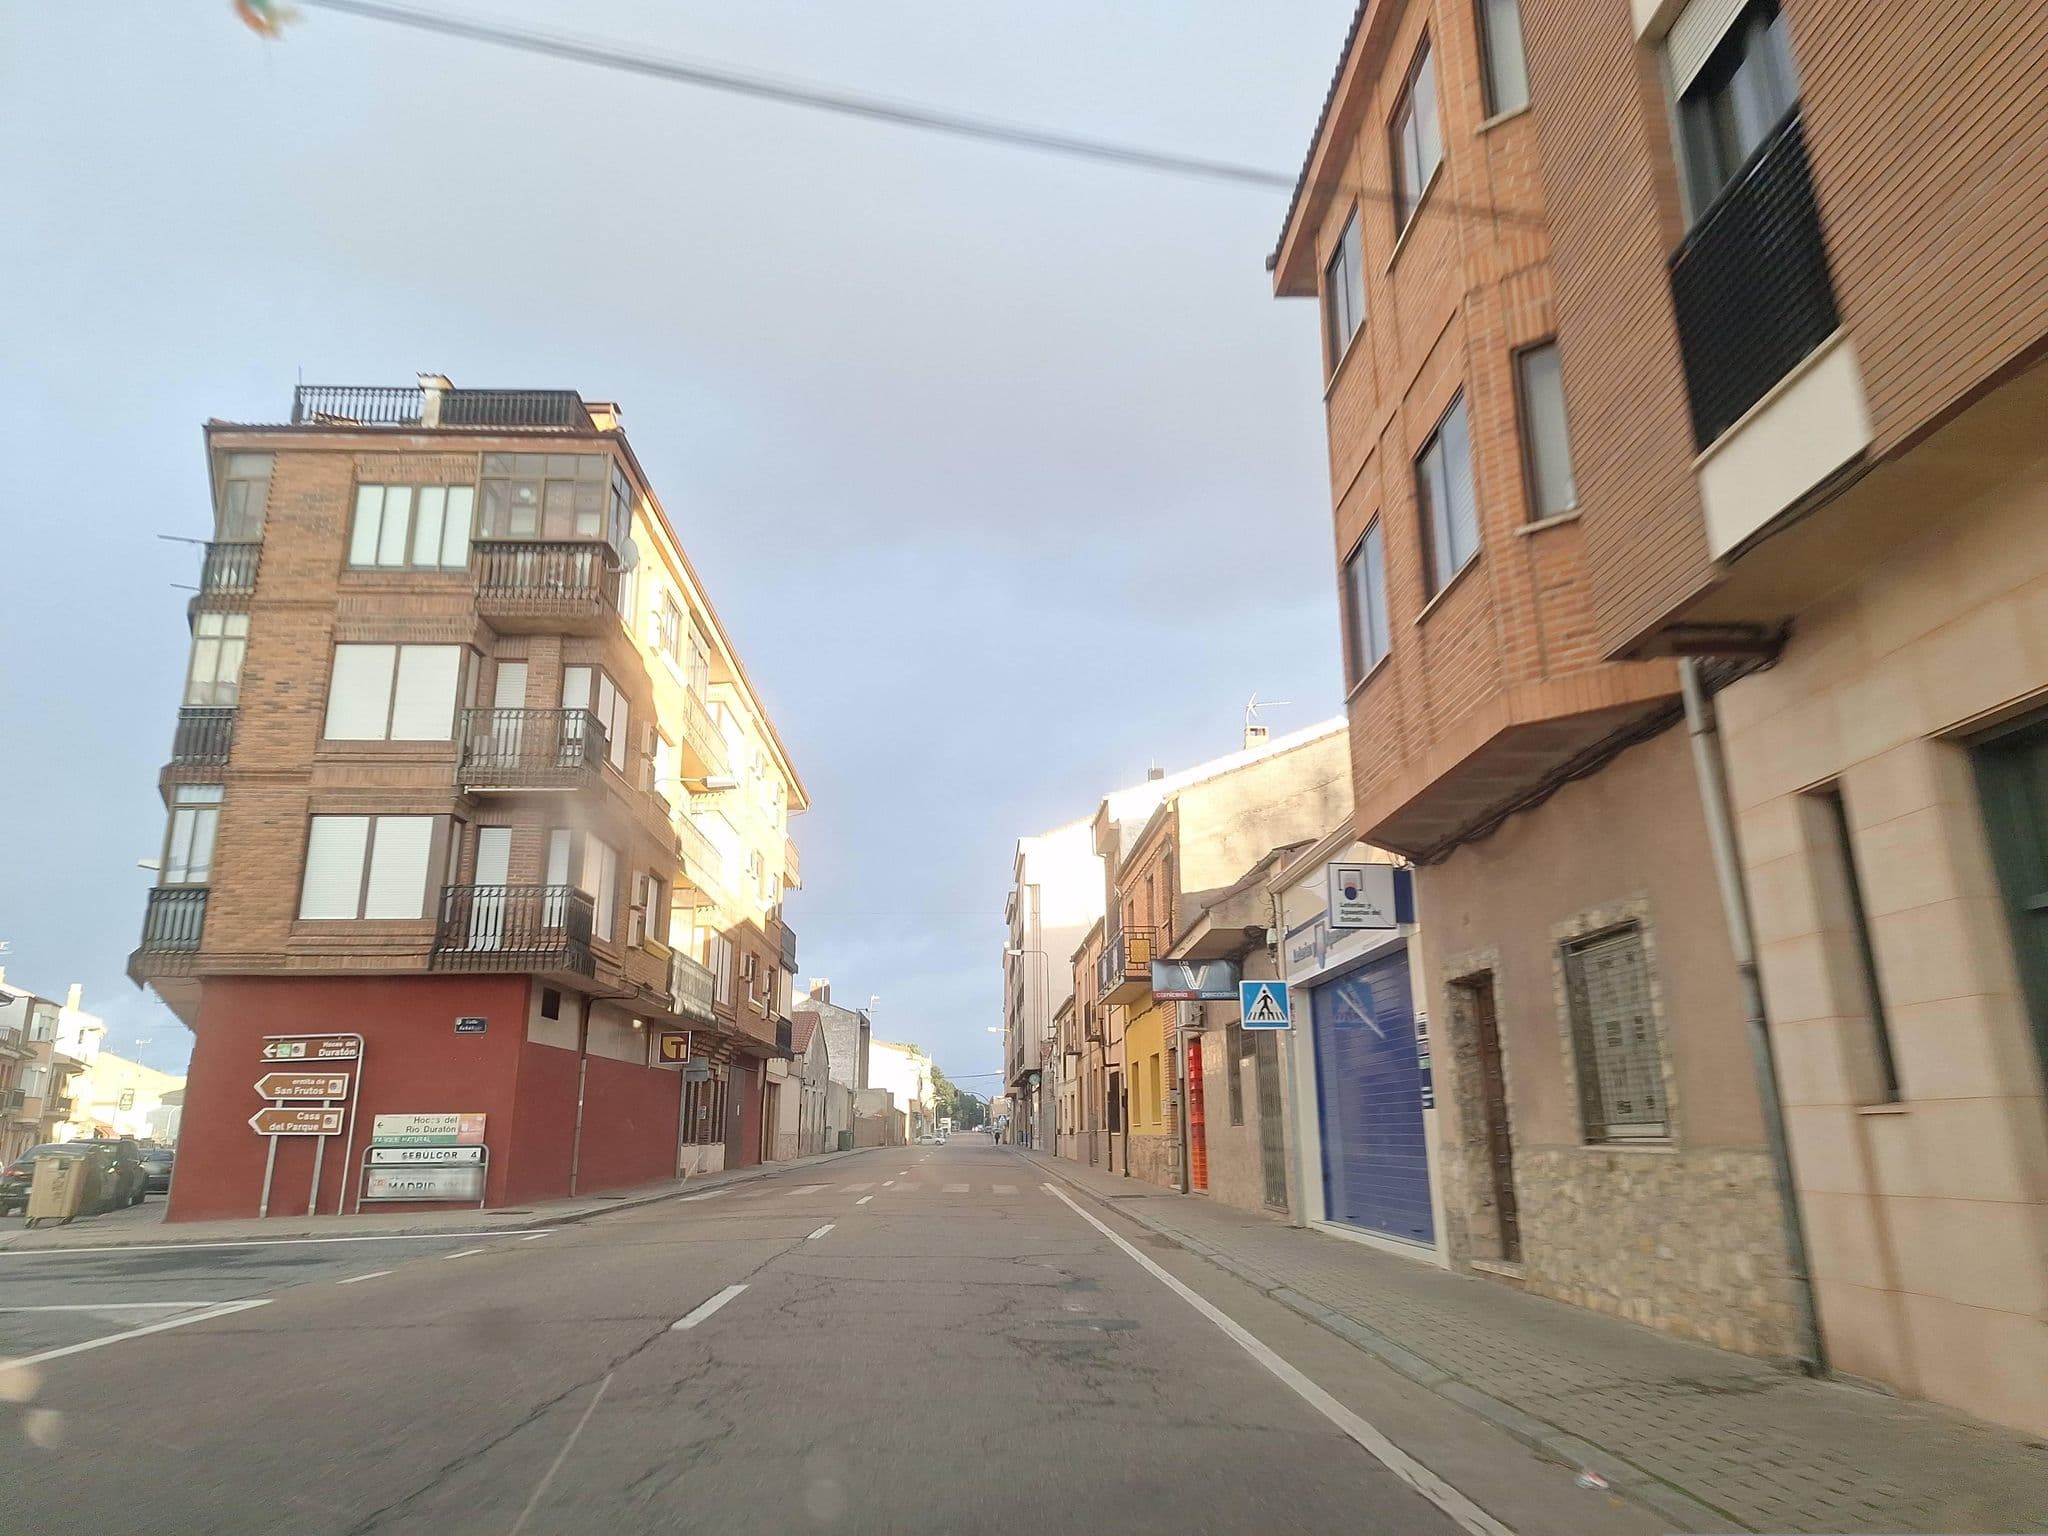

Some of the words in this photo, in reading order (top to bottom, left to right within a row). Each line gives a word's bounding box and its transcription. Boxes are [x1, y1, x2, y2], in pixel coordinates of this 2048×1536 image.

[318, 1047, 357, 1057] Duratón
[274, 1086, 293, 1095] San
[294, 1086, 325, 1095] Frutos
[296, 1112, 321, 1120] Casa
[413, 1116, 440, 1124] Hocs
[444, 1115, 458, 1124] del
[269, 1122, 285, 1131] del
[286, 1122, 320, 1133] Parque
